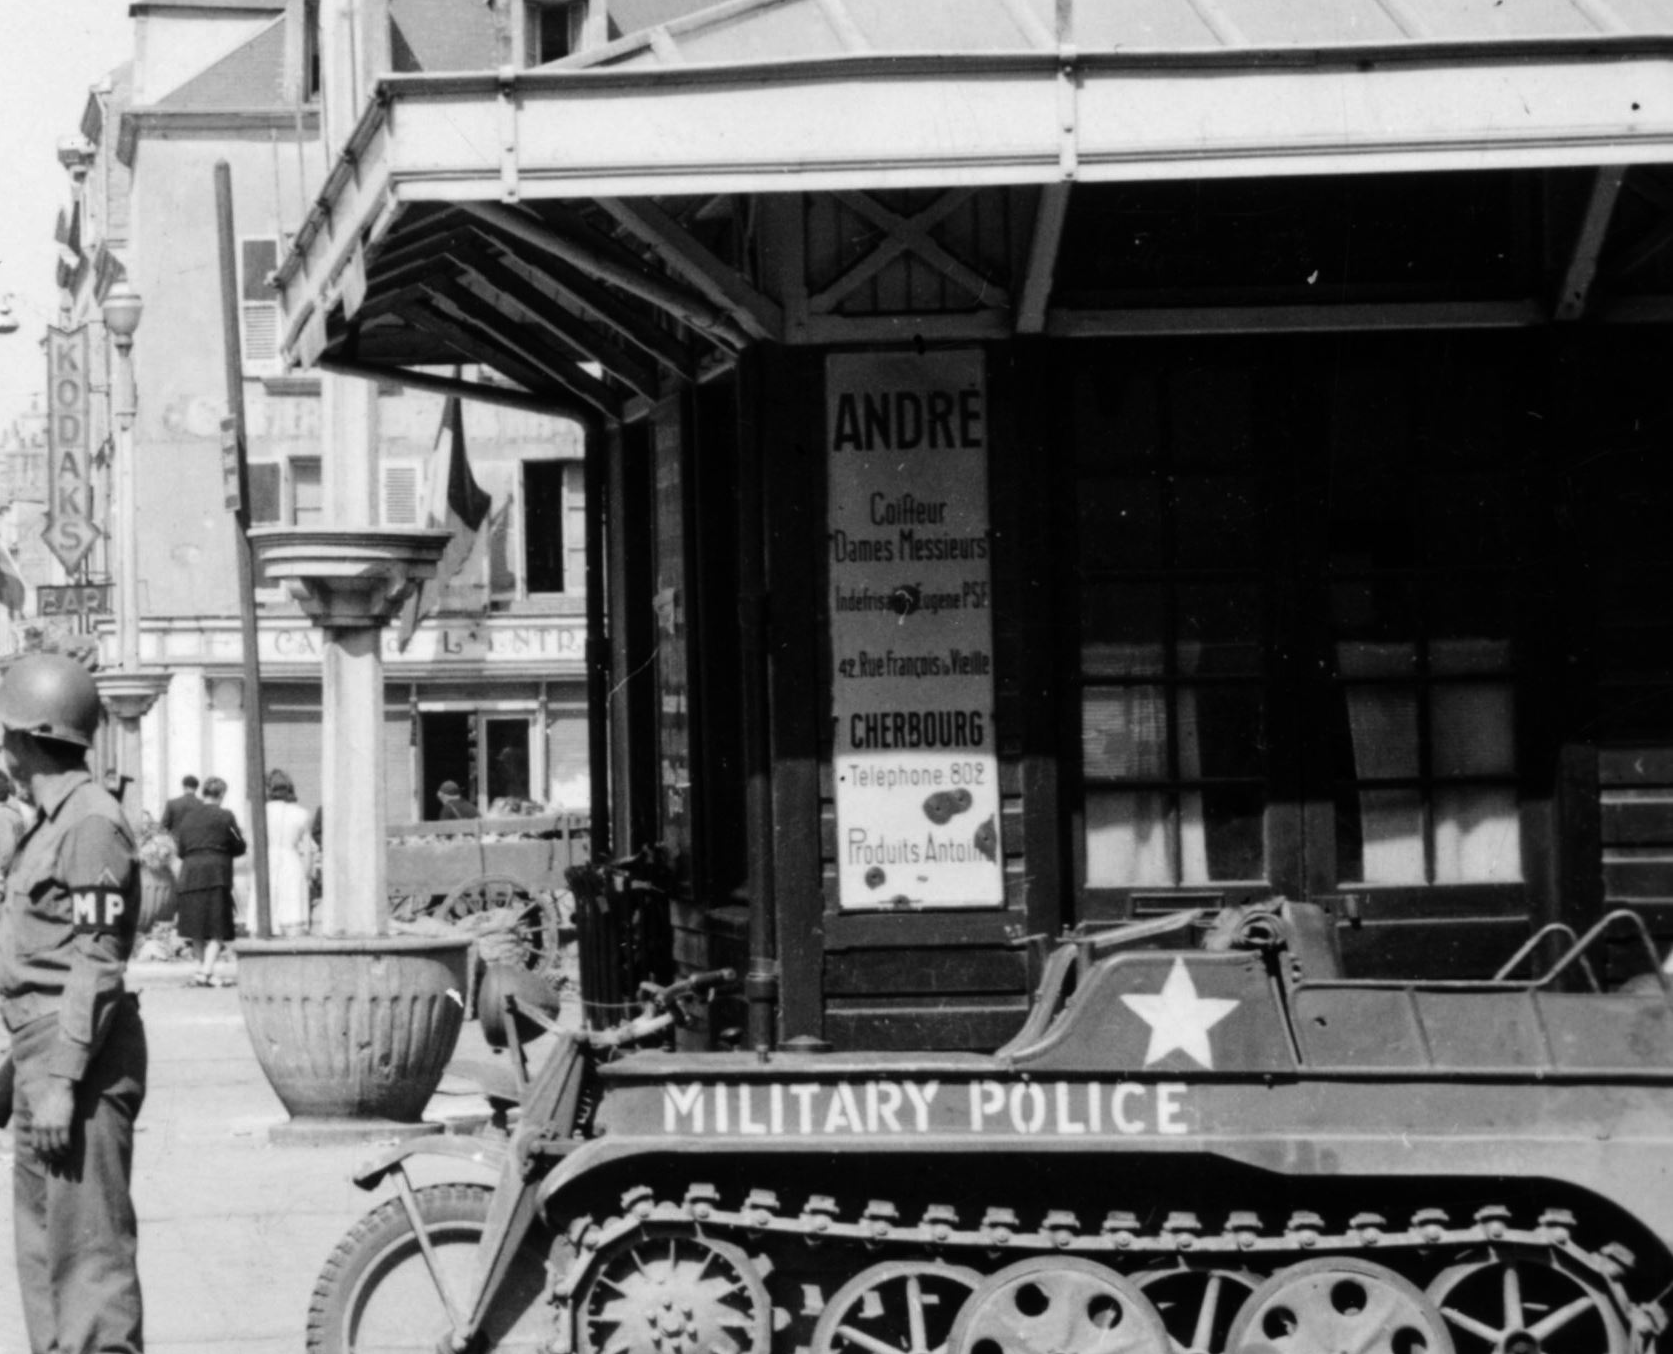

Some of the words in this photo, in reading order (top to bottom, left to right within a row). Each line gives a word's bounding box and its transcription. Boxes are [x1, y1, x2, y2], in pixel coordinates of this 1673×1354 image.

[56, 347, 83, 551] KODAKS
[869, 492, 948, 526] Coiffeur
[834, 530, 894, 563] Dames
[899, 528, 988, 562] Messieurs
[41, 588, 101, 614] BAR
[859, 650, 885, 678] Rue
[886, 649, 940, 679] François
[850, 710, 984, 749] CHERBOURG
[950, 761, 985, 786] 802
[848, 827, 921, 866] Produits
[663, 1081, 939, 1134] MILITARY
[970, 1080, 1188, 1134] POLICE
